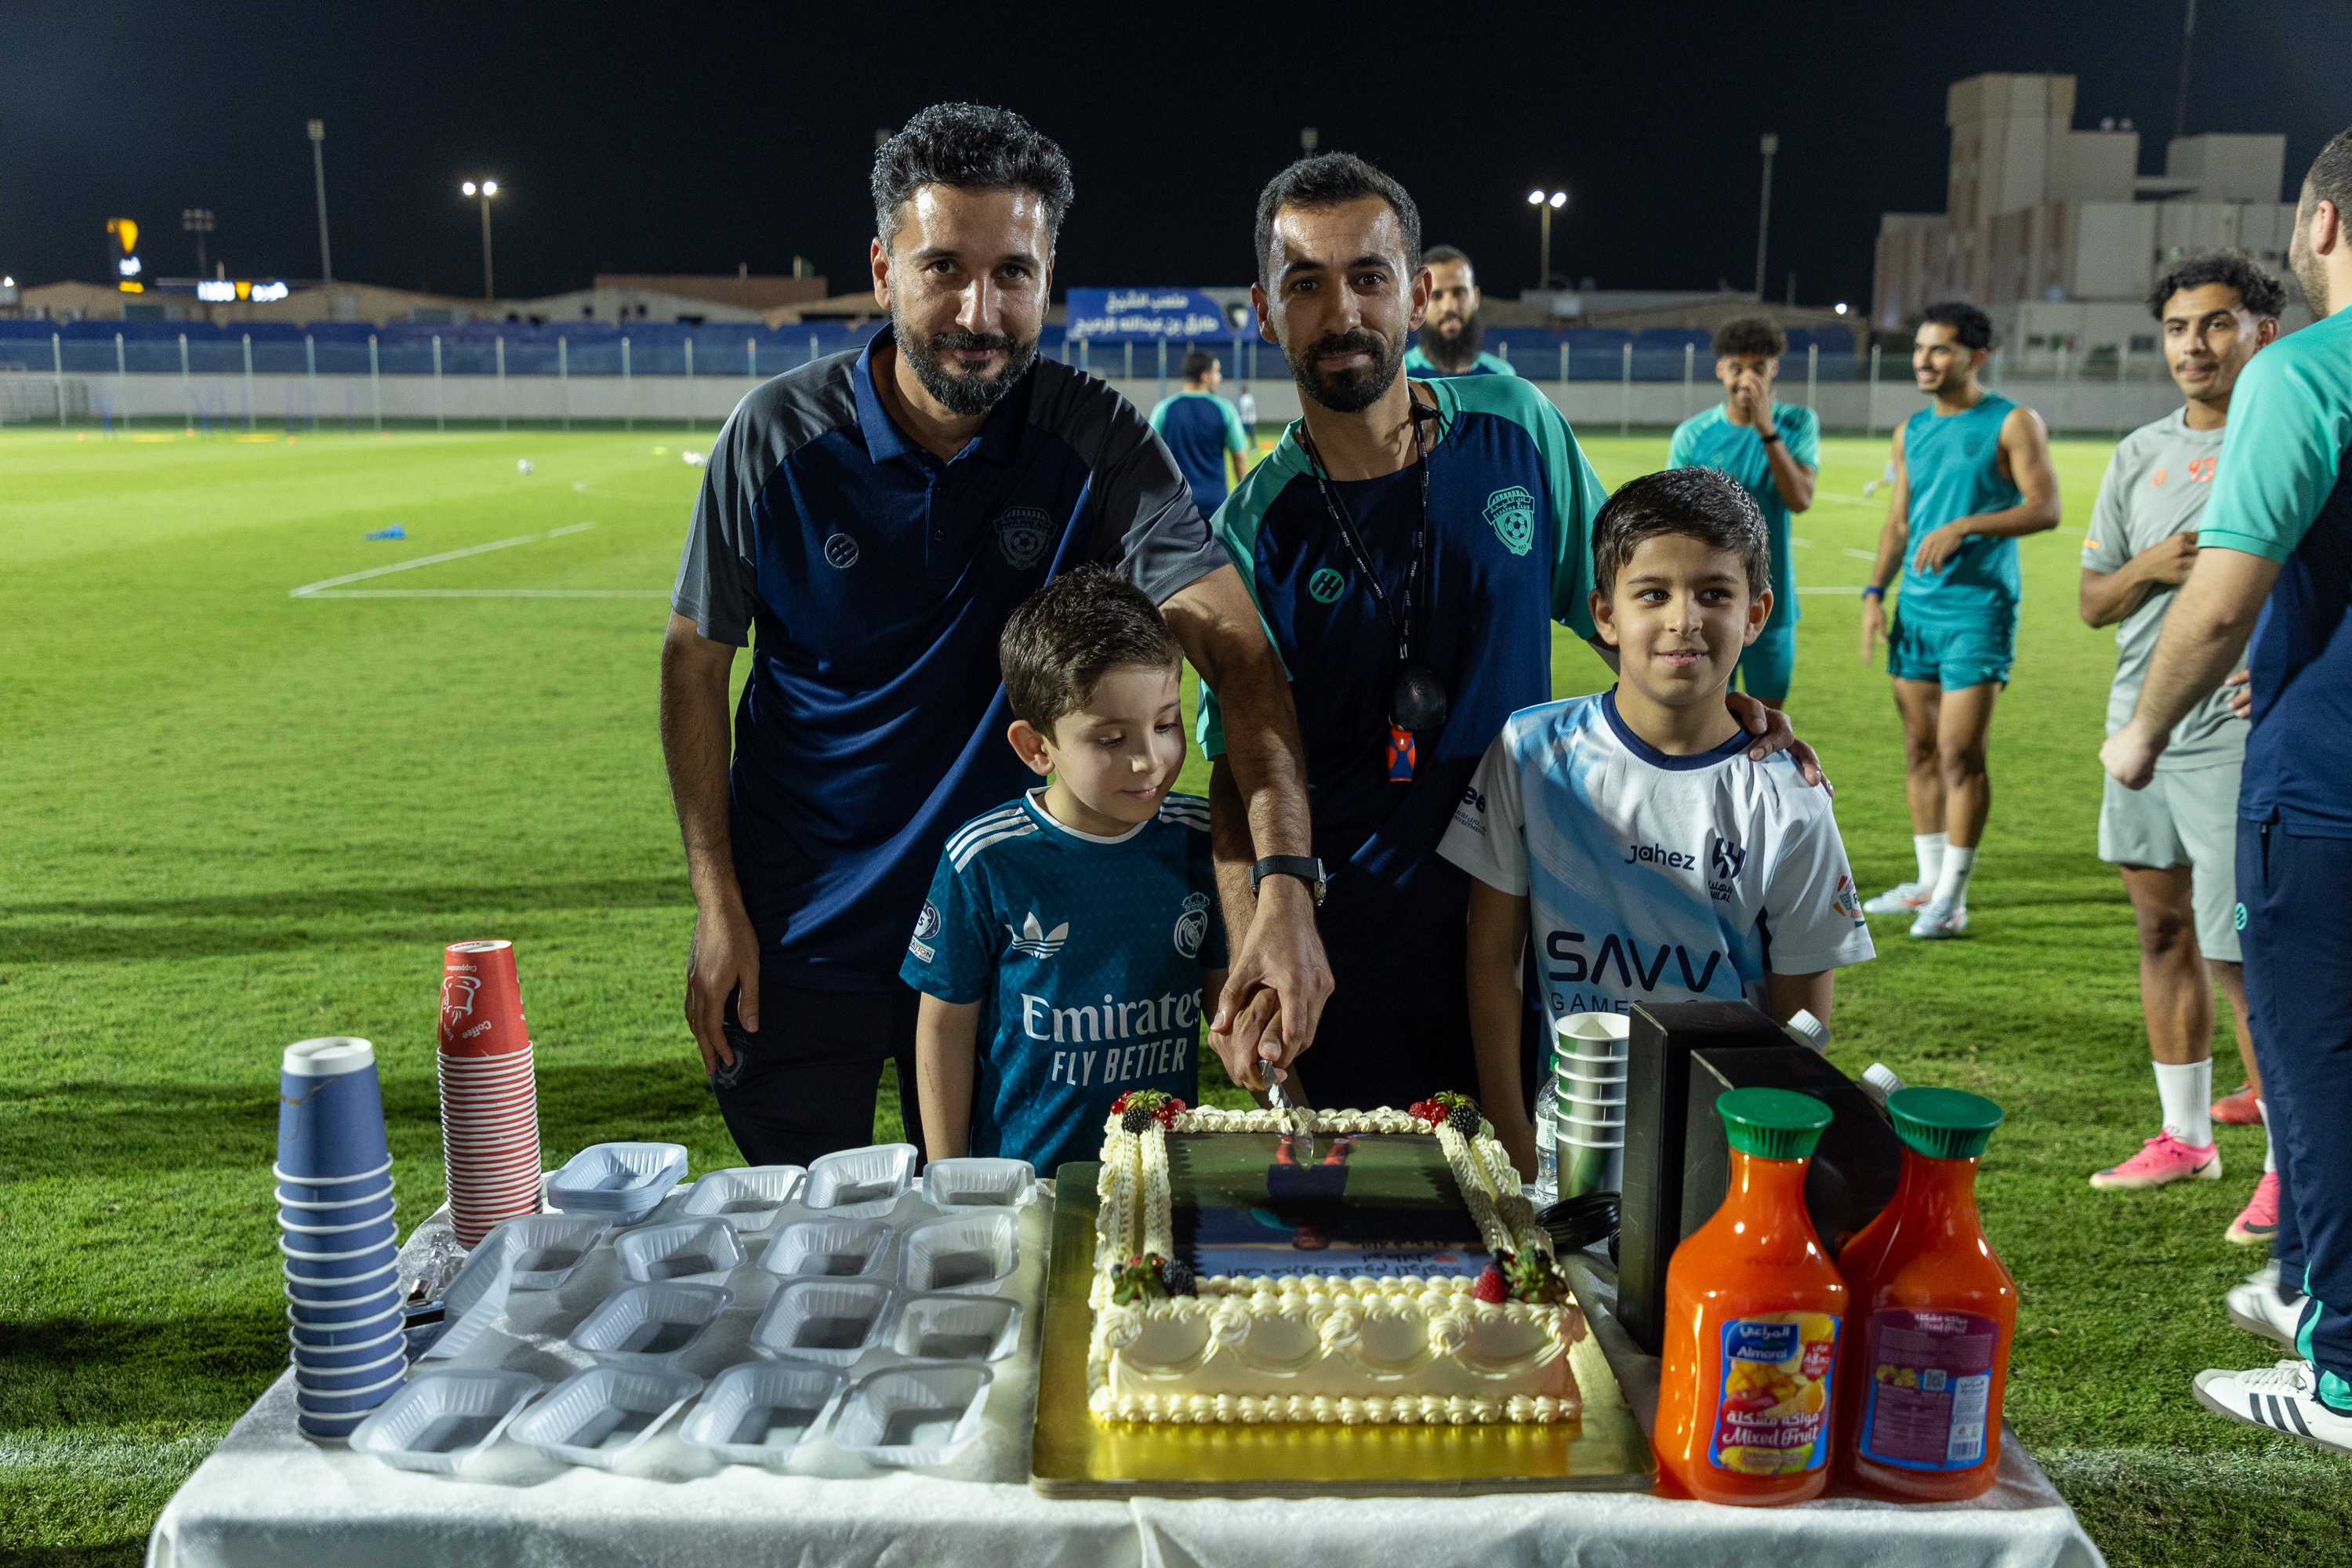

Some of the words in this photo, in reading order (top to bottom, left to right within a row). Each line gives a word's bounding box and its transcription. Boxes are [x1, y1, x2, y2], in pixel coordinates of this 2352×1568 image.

[1493, 505, 1516, 519] ALFAYHA
[1547, 931, 1747, 998] SAVV
[1551, 992, 1642, 1014] GAME
[1021, 988, 1202, 1043] Emirates
[462, 1020, 492, 1039] Coffee
[1051, 1050, 1098, 1087] FLY
[1103, 1037, 1189, 1084] BETTER
[1739, 1325, 1791, 1340] المراعي
[1736, 1345, 1788, 1359] Almarai
[1726, 1410, 1779, 1427] مشكلة
[1722, 1427, 1779, 1446] Mixed
[1781, 1425, 1820, 1446] Fruit
